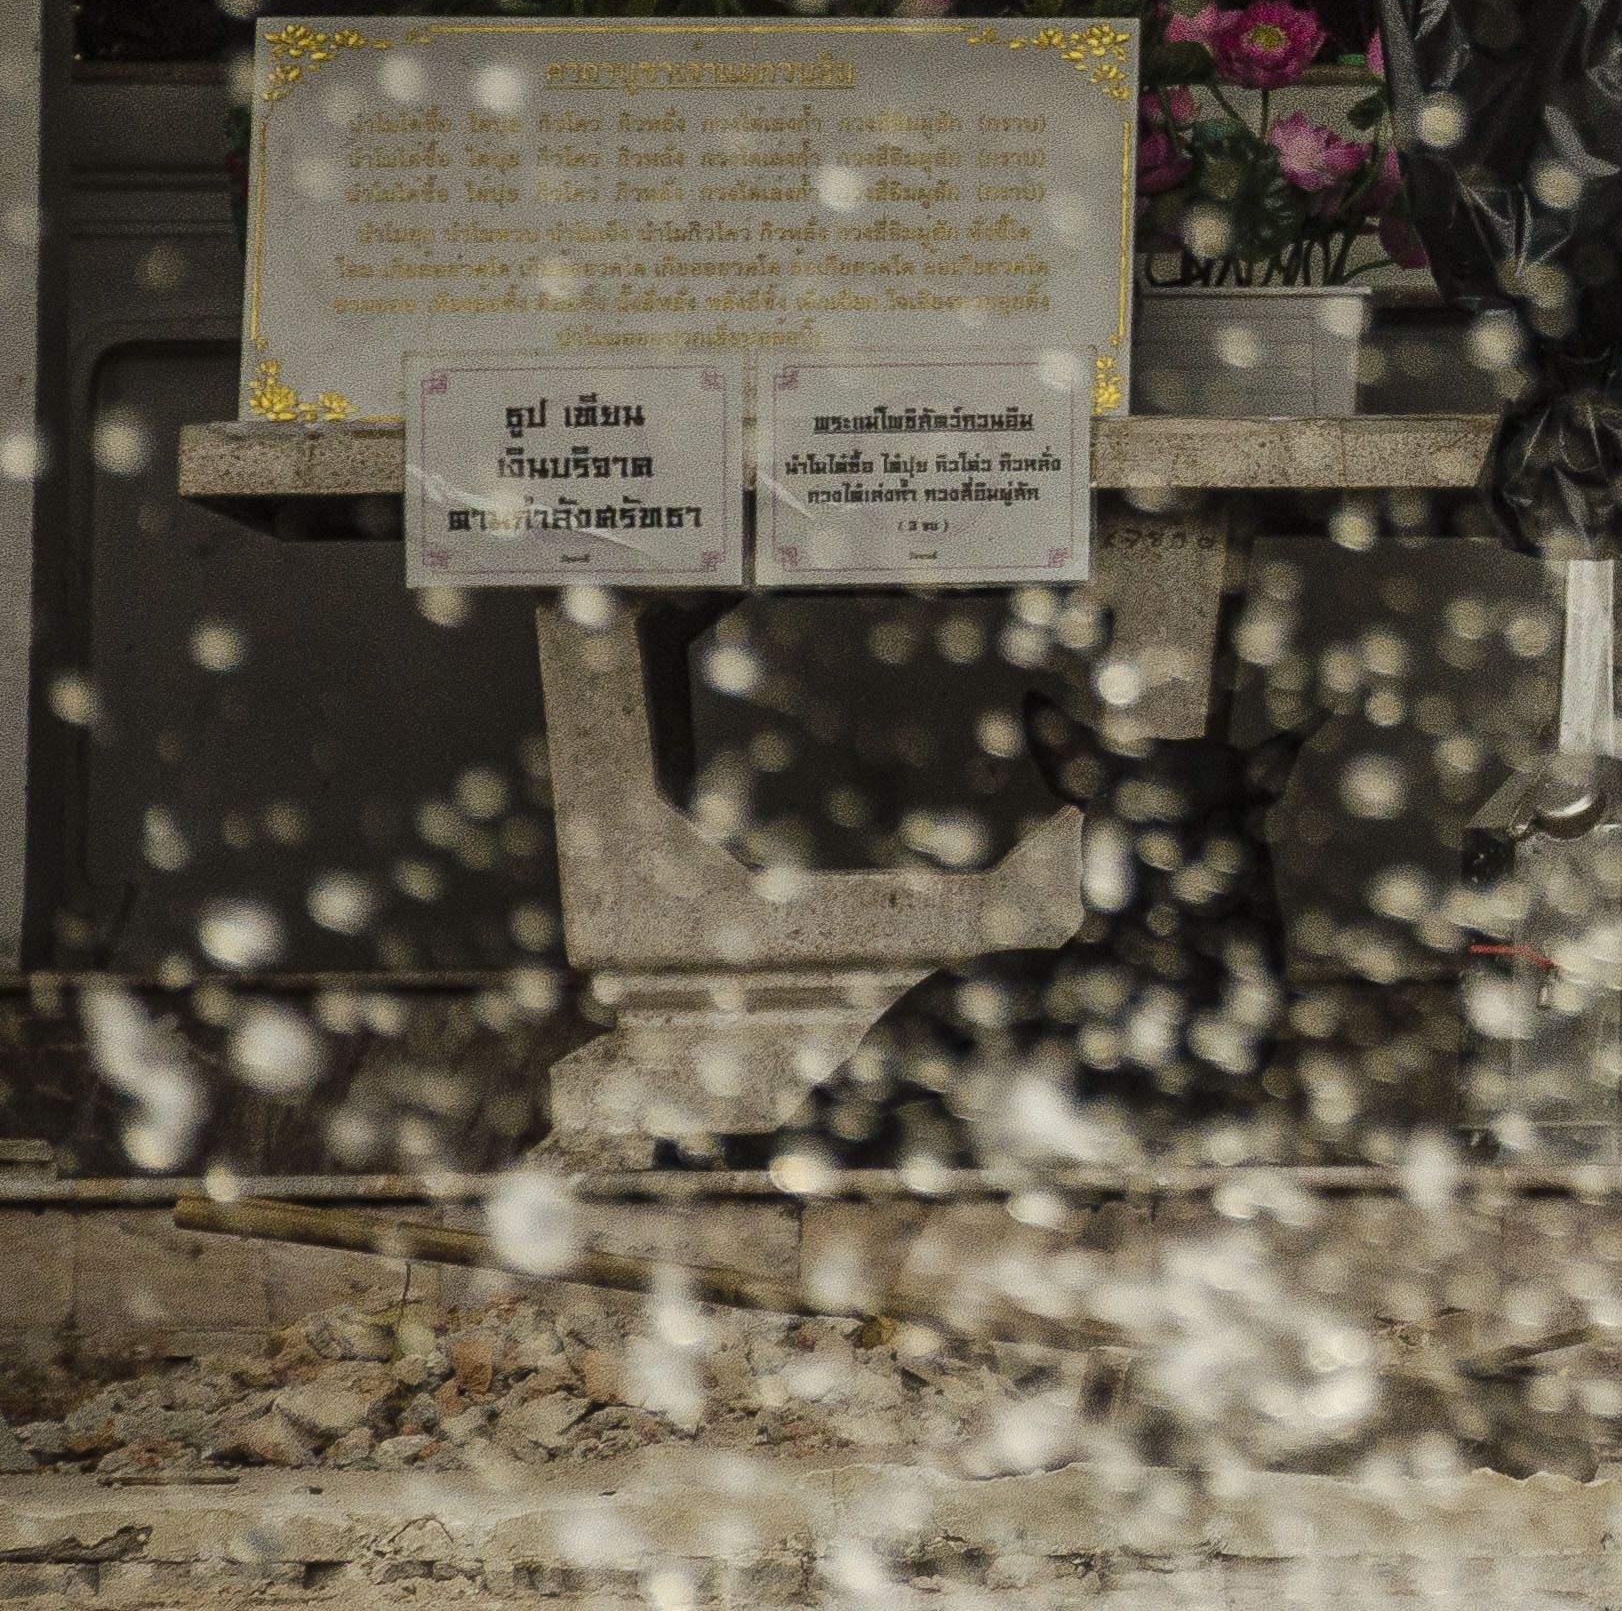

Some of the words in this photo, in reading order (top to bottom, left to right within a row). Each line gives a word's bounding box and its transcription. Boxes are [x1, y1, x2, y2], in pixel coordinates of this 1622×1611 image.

[506, 397, 548, 438] ธูป
[565, 392, 645, 428] เทียน
[498, 446, 654, 479] เงินบริจาค
[449, 495, 703, 531] ตากำลังศรัทธา
